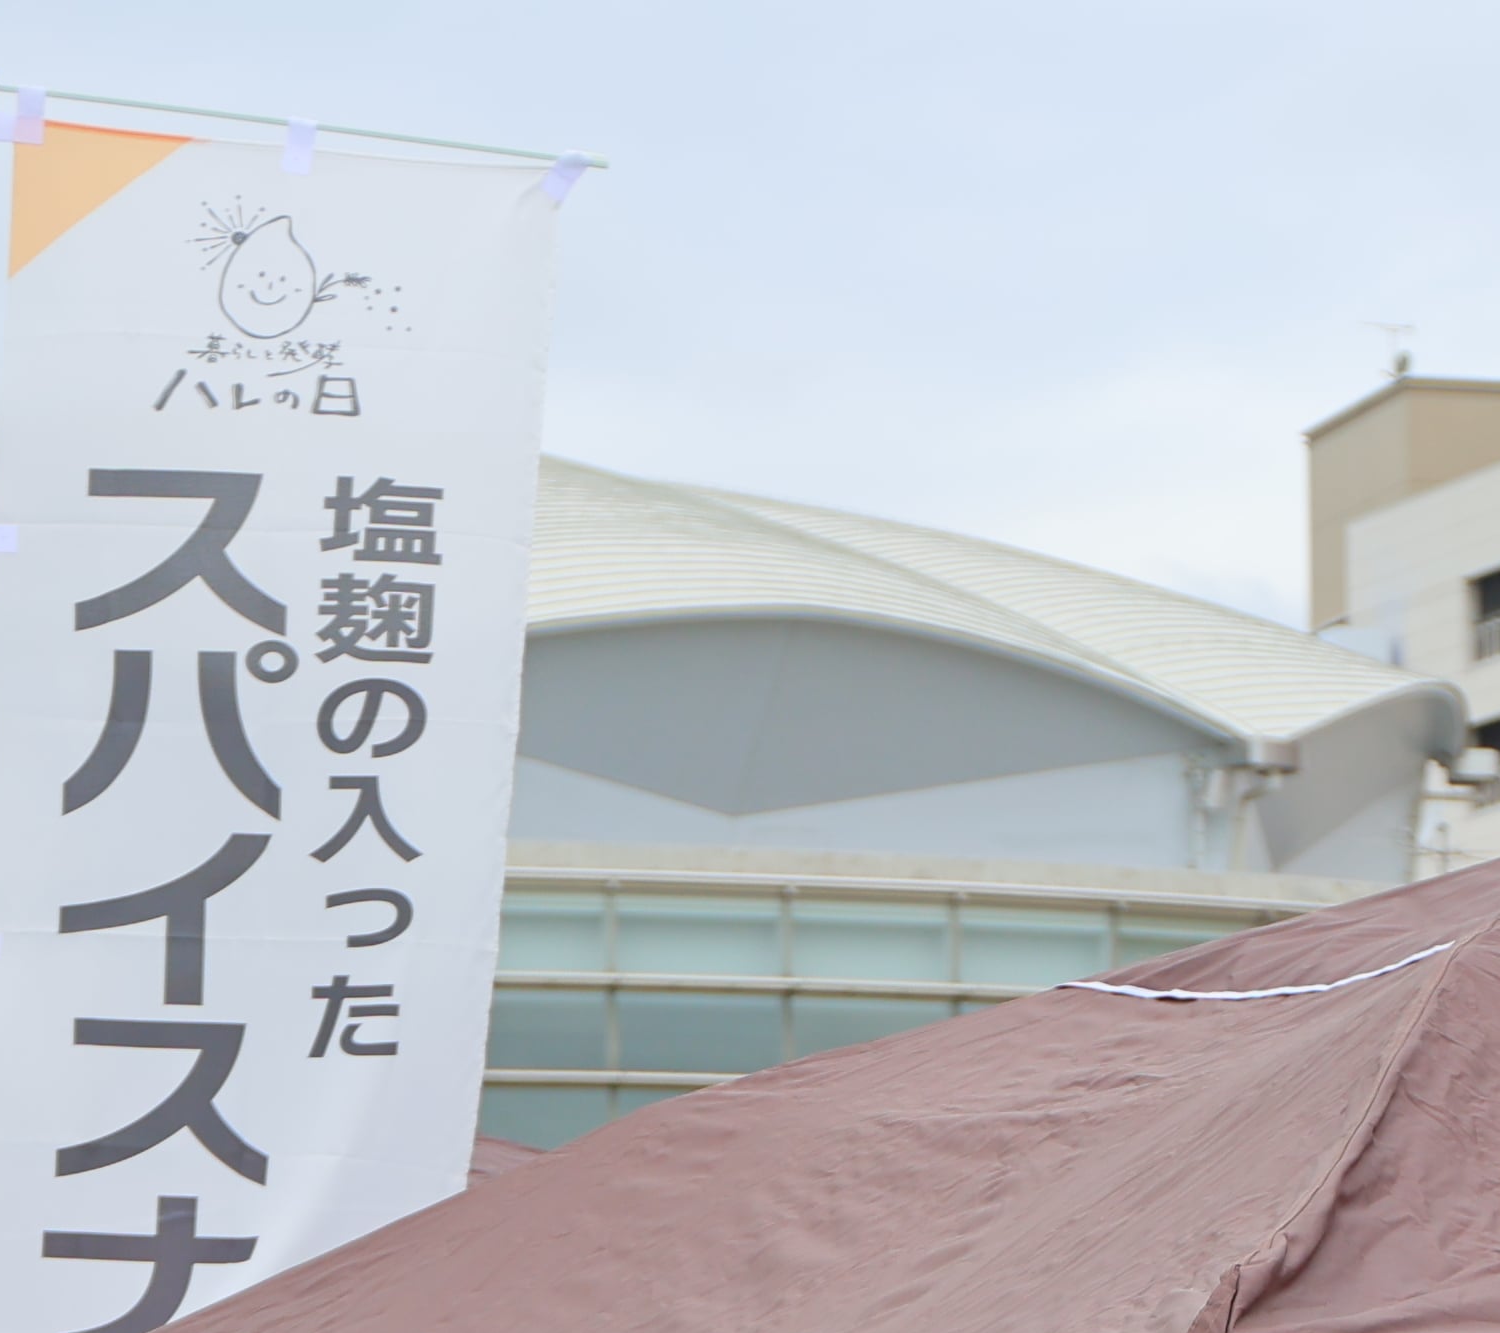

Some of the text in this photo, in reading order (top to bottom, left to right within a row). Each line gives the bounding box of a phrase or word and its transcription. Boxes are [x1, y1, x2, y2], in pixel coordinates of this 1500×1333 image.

[154, 368, 360, 416] ハレの日
[306, 475, 444, 1060] 塩麹の入った
